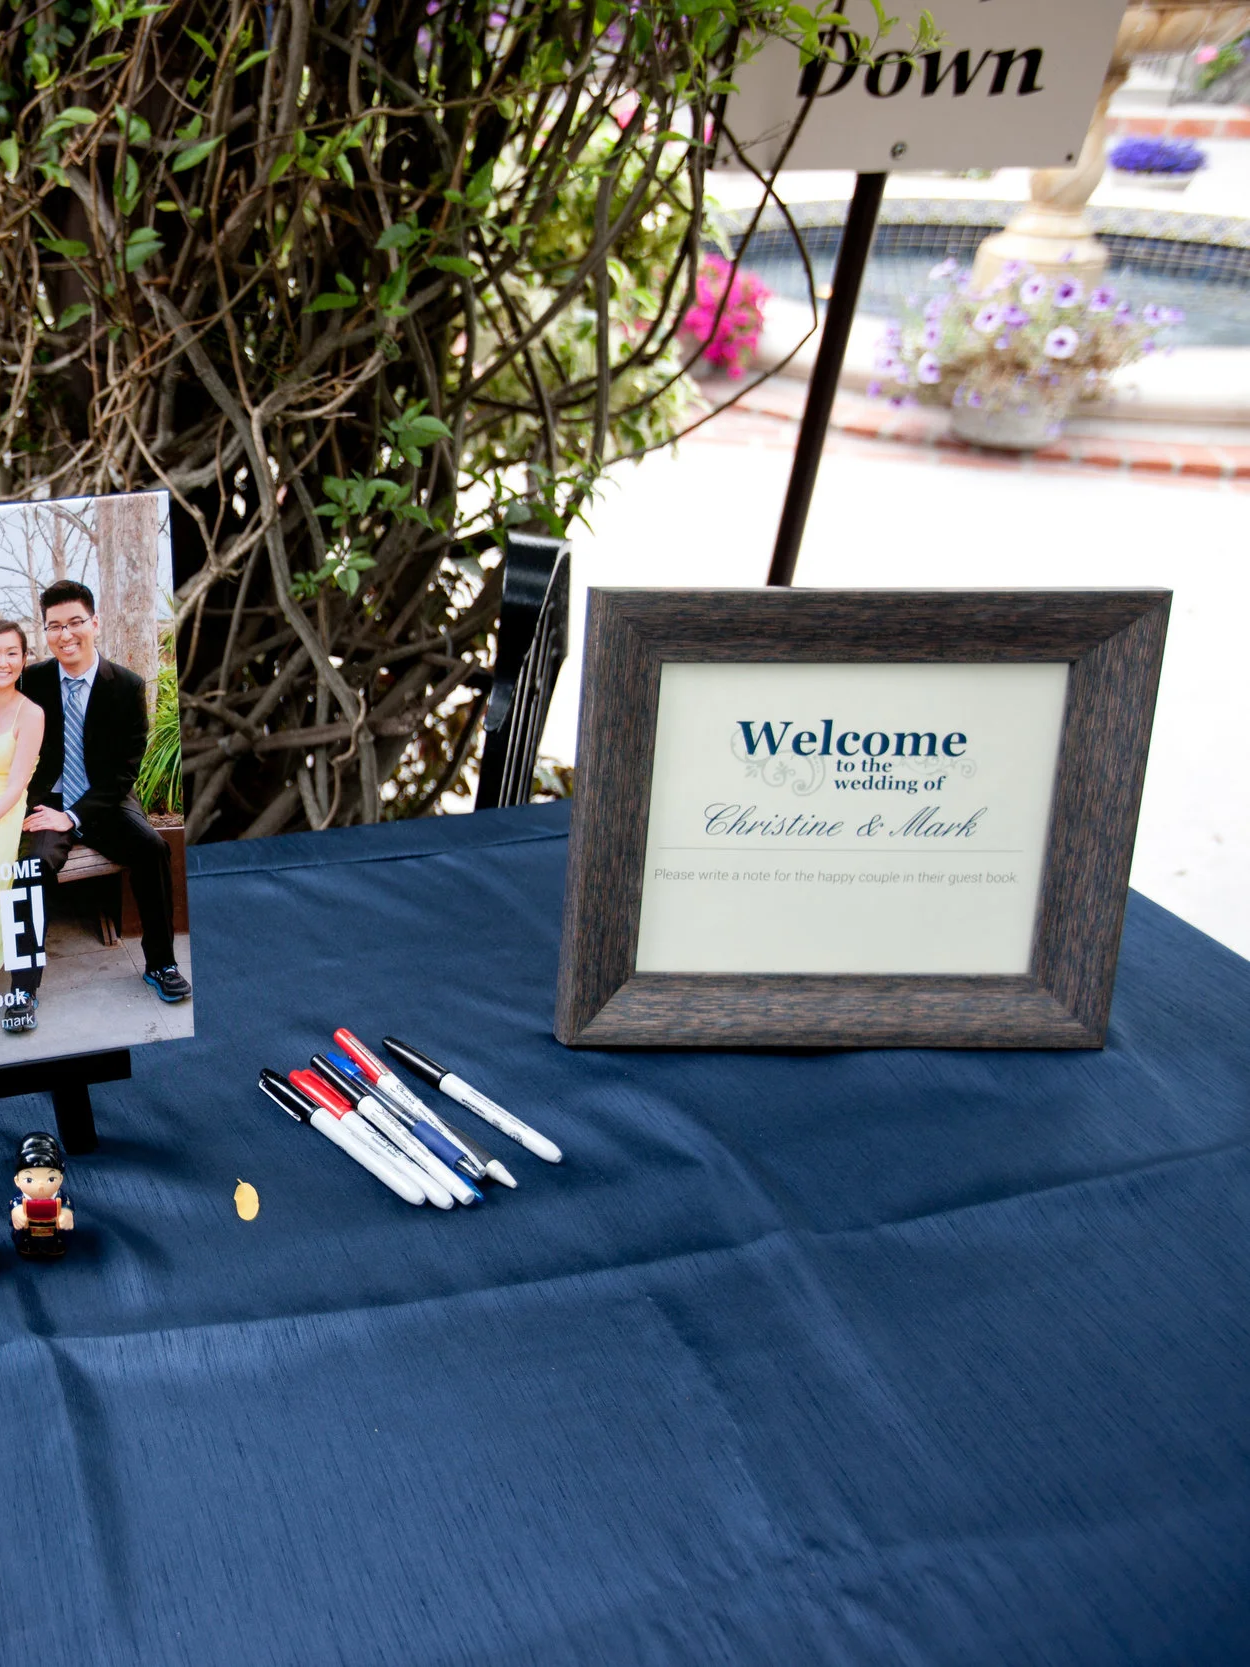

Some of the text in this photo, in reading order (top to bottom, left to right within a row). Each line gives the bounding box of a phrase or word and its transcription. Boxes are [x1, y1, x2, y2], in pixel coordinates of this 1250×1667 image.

[796, 30, 1044, 98] Down
[736, 719, 967, 757] Welcome
[836, 758, 892, 772] to the
[834, 775, 946, 795] wedding of
[704, 803, 988, 837] Christine & Mark
[654, 868, 695, 881] Please
[699, 869, 729, 881] write
[732, 872, 740, 881] a
[743, 870, 771, 882] note
[774, 869, 792, 882] for
[795, 870, 815, 882] the
[818, 870, 856, 885] happy
[859, 871, 901, 885] couple
[903, 872, 914, 883] in
[918, 871, 945, 884] their
[948, 872, 983, 887] guest
[1, 1013, 35, 1029] mark
